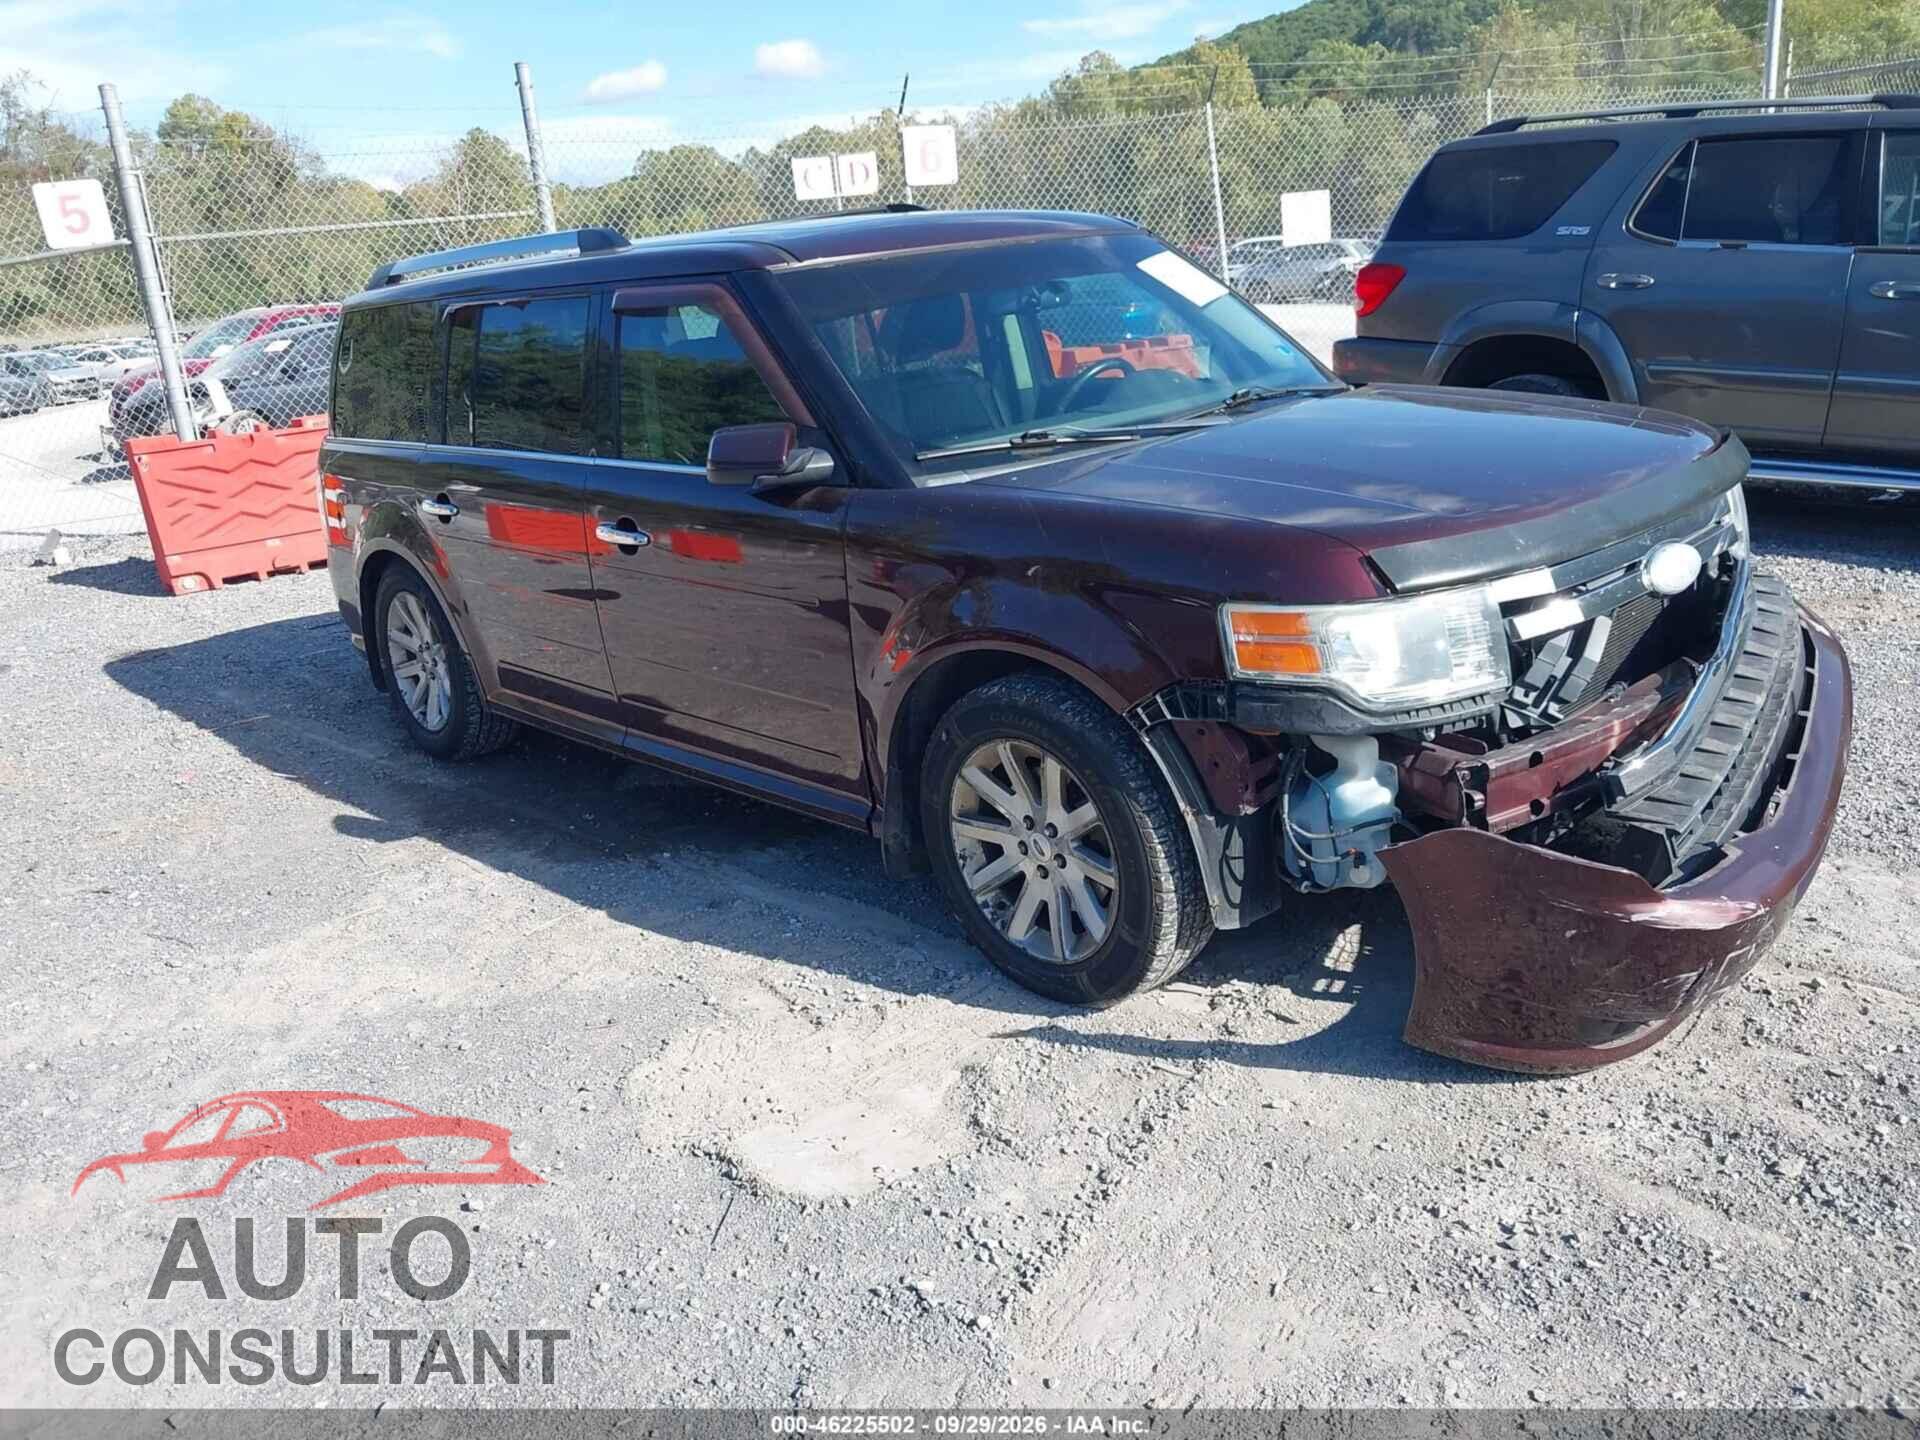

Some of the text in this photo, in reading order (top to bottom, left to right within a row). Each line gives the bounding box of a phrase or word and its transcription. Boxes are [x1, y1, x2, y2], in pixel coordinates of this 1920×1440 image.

[848, 160, 870, 187] D
[919, 138, 943, 174] 6
[59, 194, 91, 235] 5
